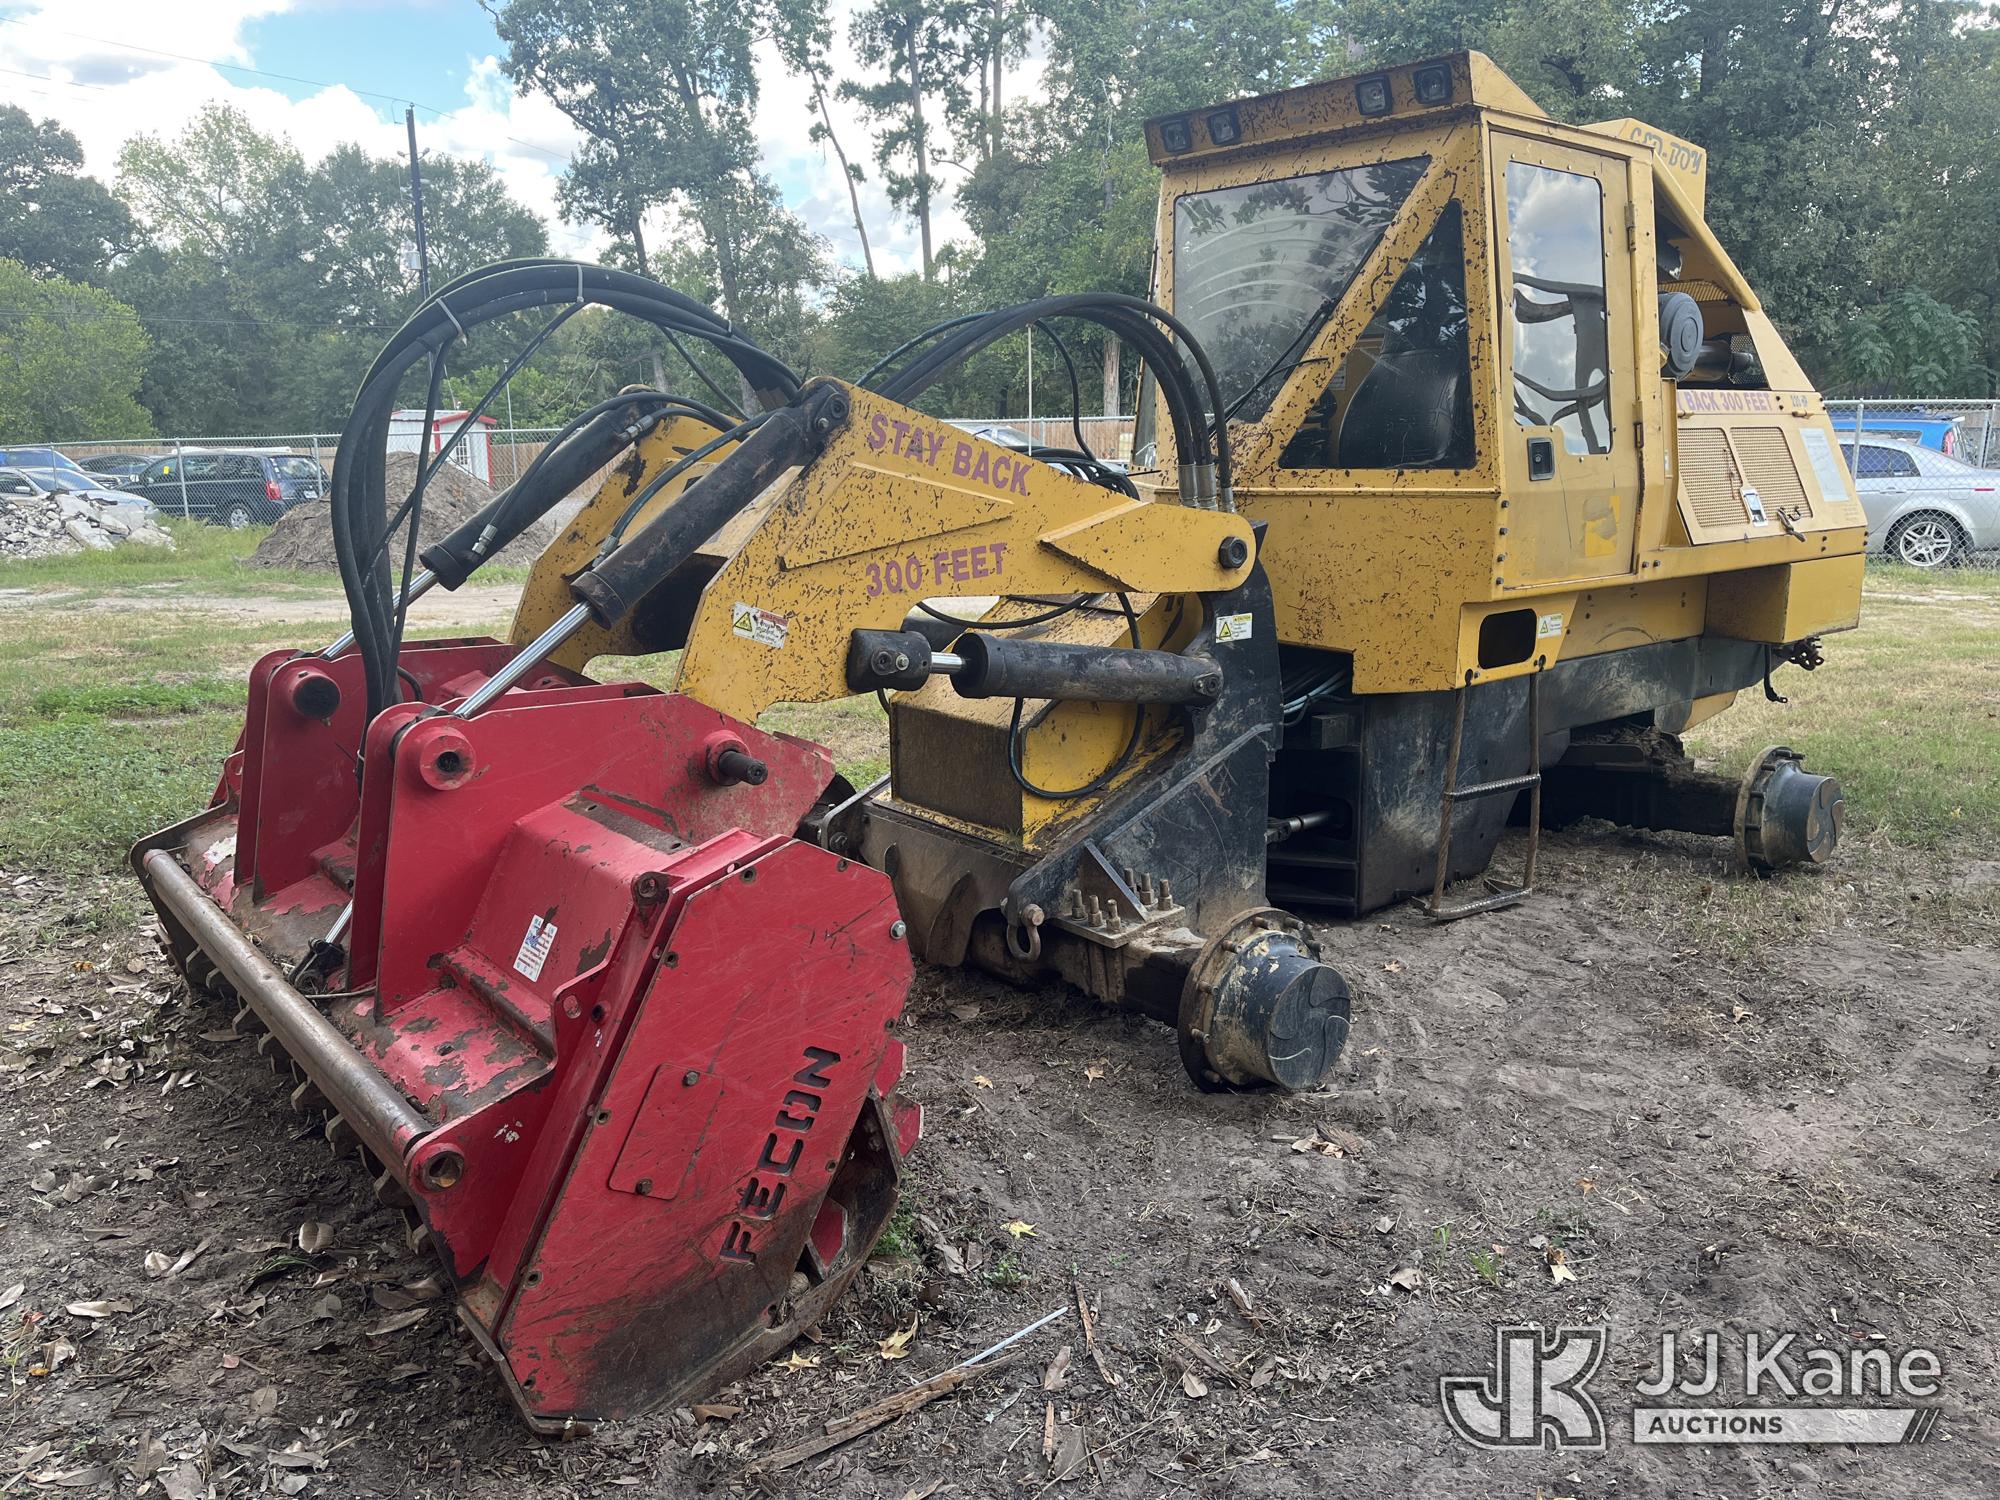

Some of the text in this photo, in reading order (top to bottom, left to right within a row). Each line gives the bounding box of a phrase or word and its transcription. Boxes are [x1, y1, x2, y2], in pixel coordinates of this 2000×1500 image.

[1685, 391, 1720, 411] BACK
[1720, 392, 1744, 411] 300
[1744, 392, 1773, 411] FEET
[867, 414, 1033, 497] STAY BACK
[866, 542, 1008, 597] 300 FEET
[719, 1045, 841, 1267] FECON
